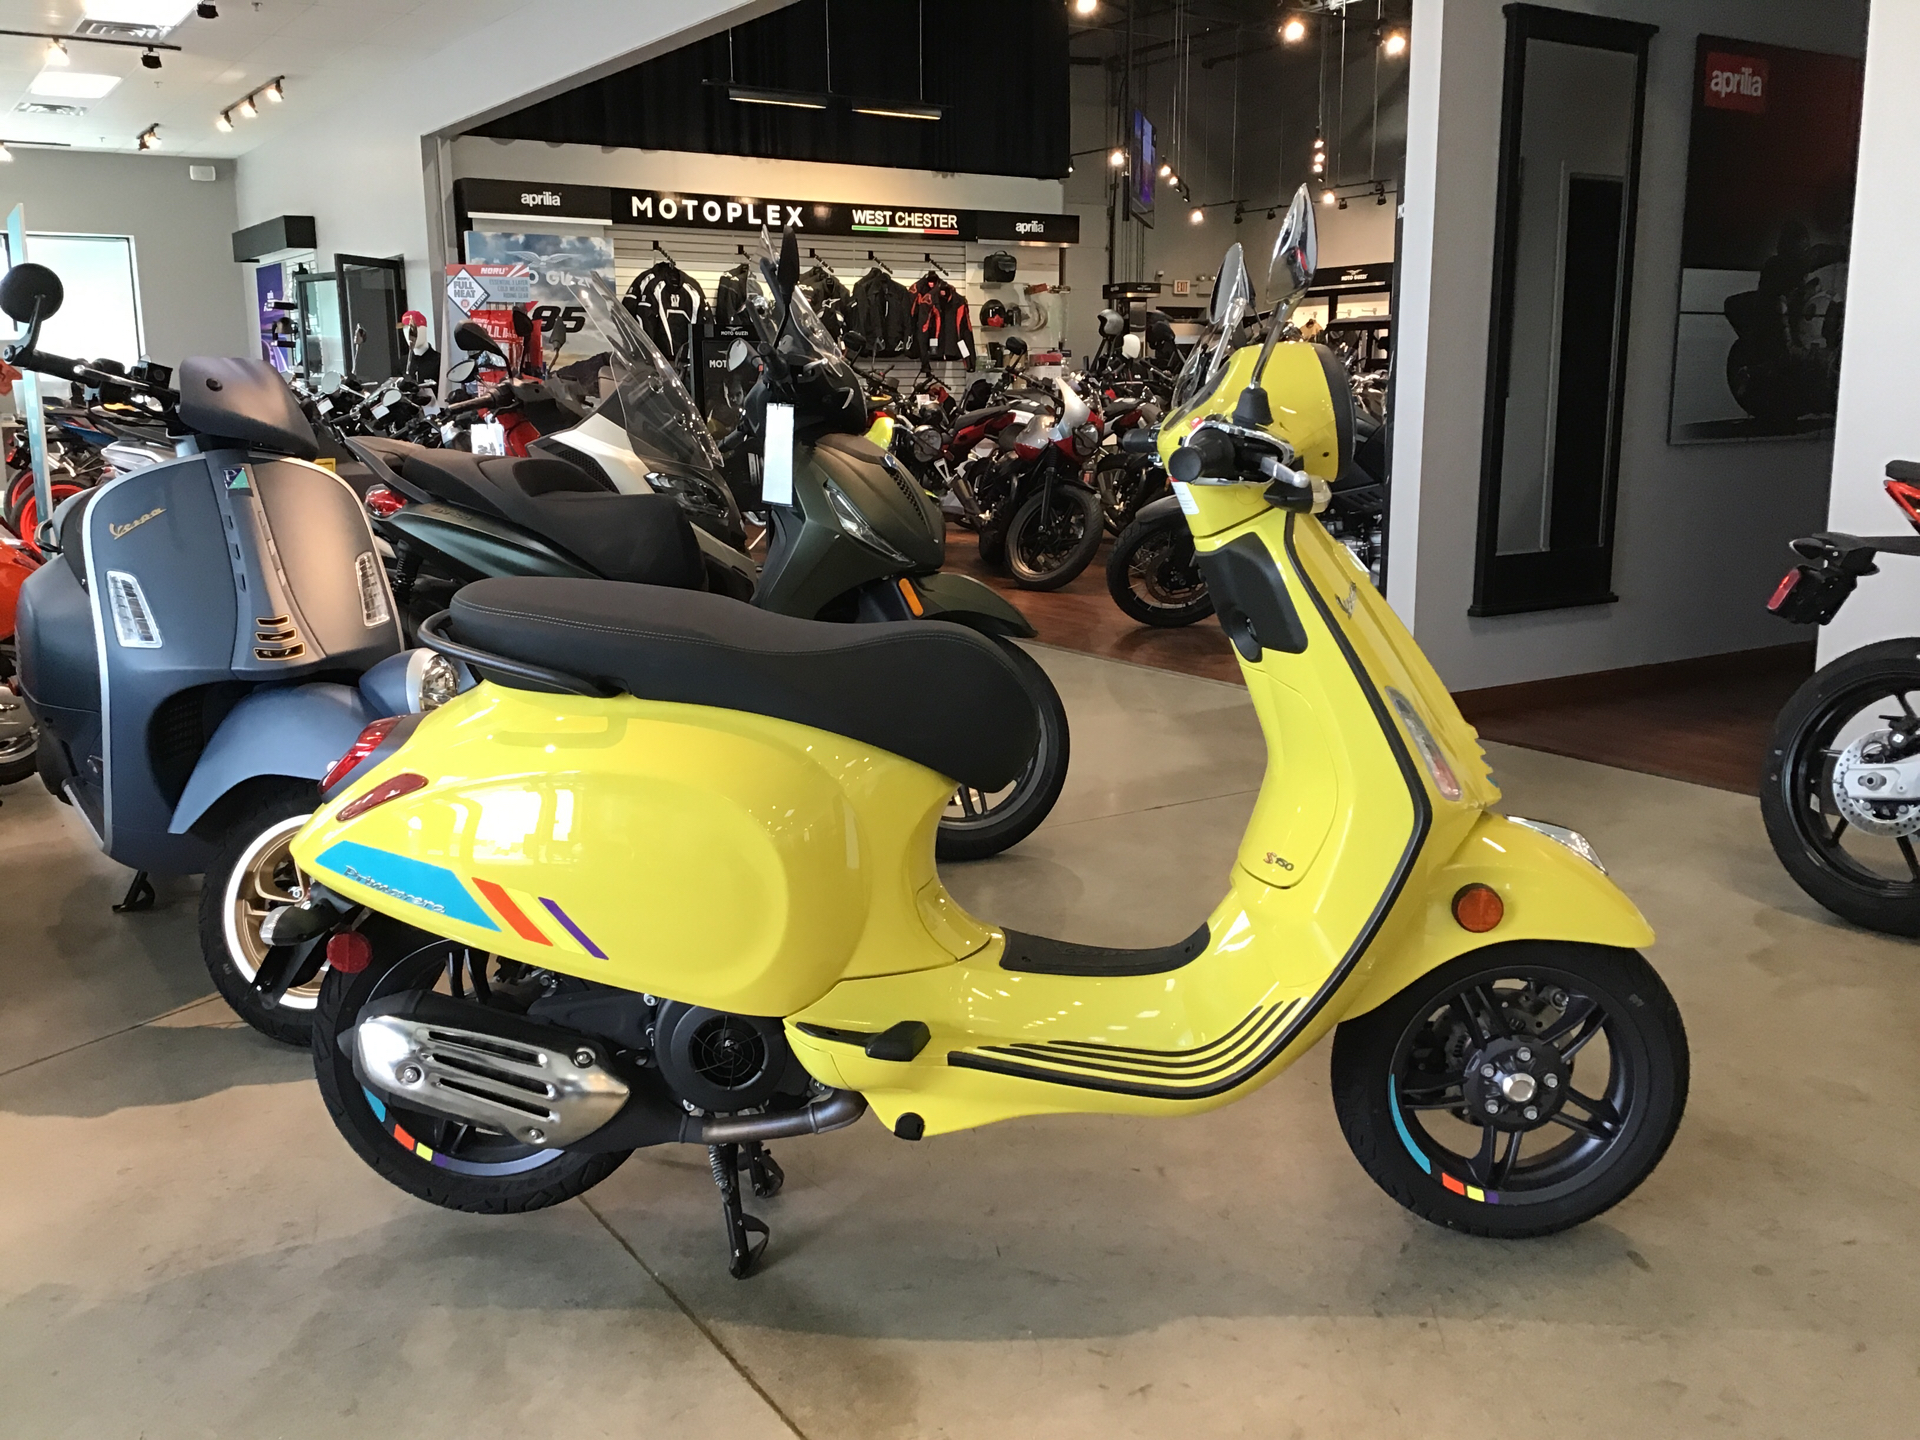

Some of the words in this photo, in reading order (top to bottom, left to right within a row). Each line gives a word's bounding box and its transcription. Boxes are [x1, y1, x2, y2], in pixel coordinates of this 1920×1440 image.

[1710, 67, 1762, 98] aprilia
[520, 190, 561, 208] aprilia
[631, 195, 804, 228] MOTOPLEX
[852, 209, 892, 225] WEST
[895, 211, 958, 229] CHESTER
[1015, 220, 1044, 233] aprilia
[453, 281, 474, 290] FULL
[453, 289, 476, 299] HEAT
[1177, 281, 1188, 292] EXIT
[109, 507, 167, 541] Vespa
